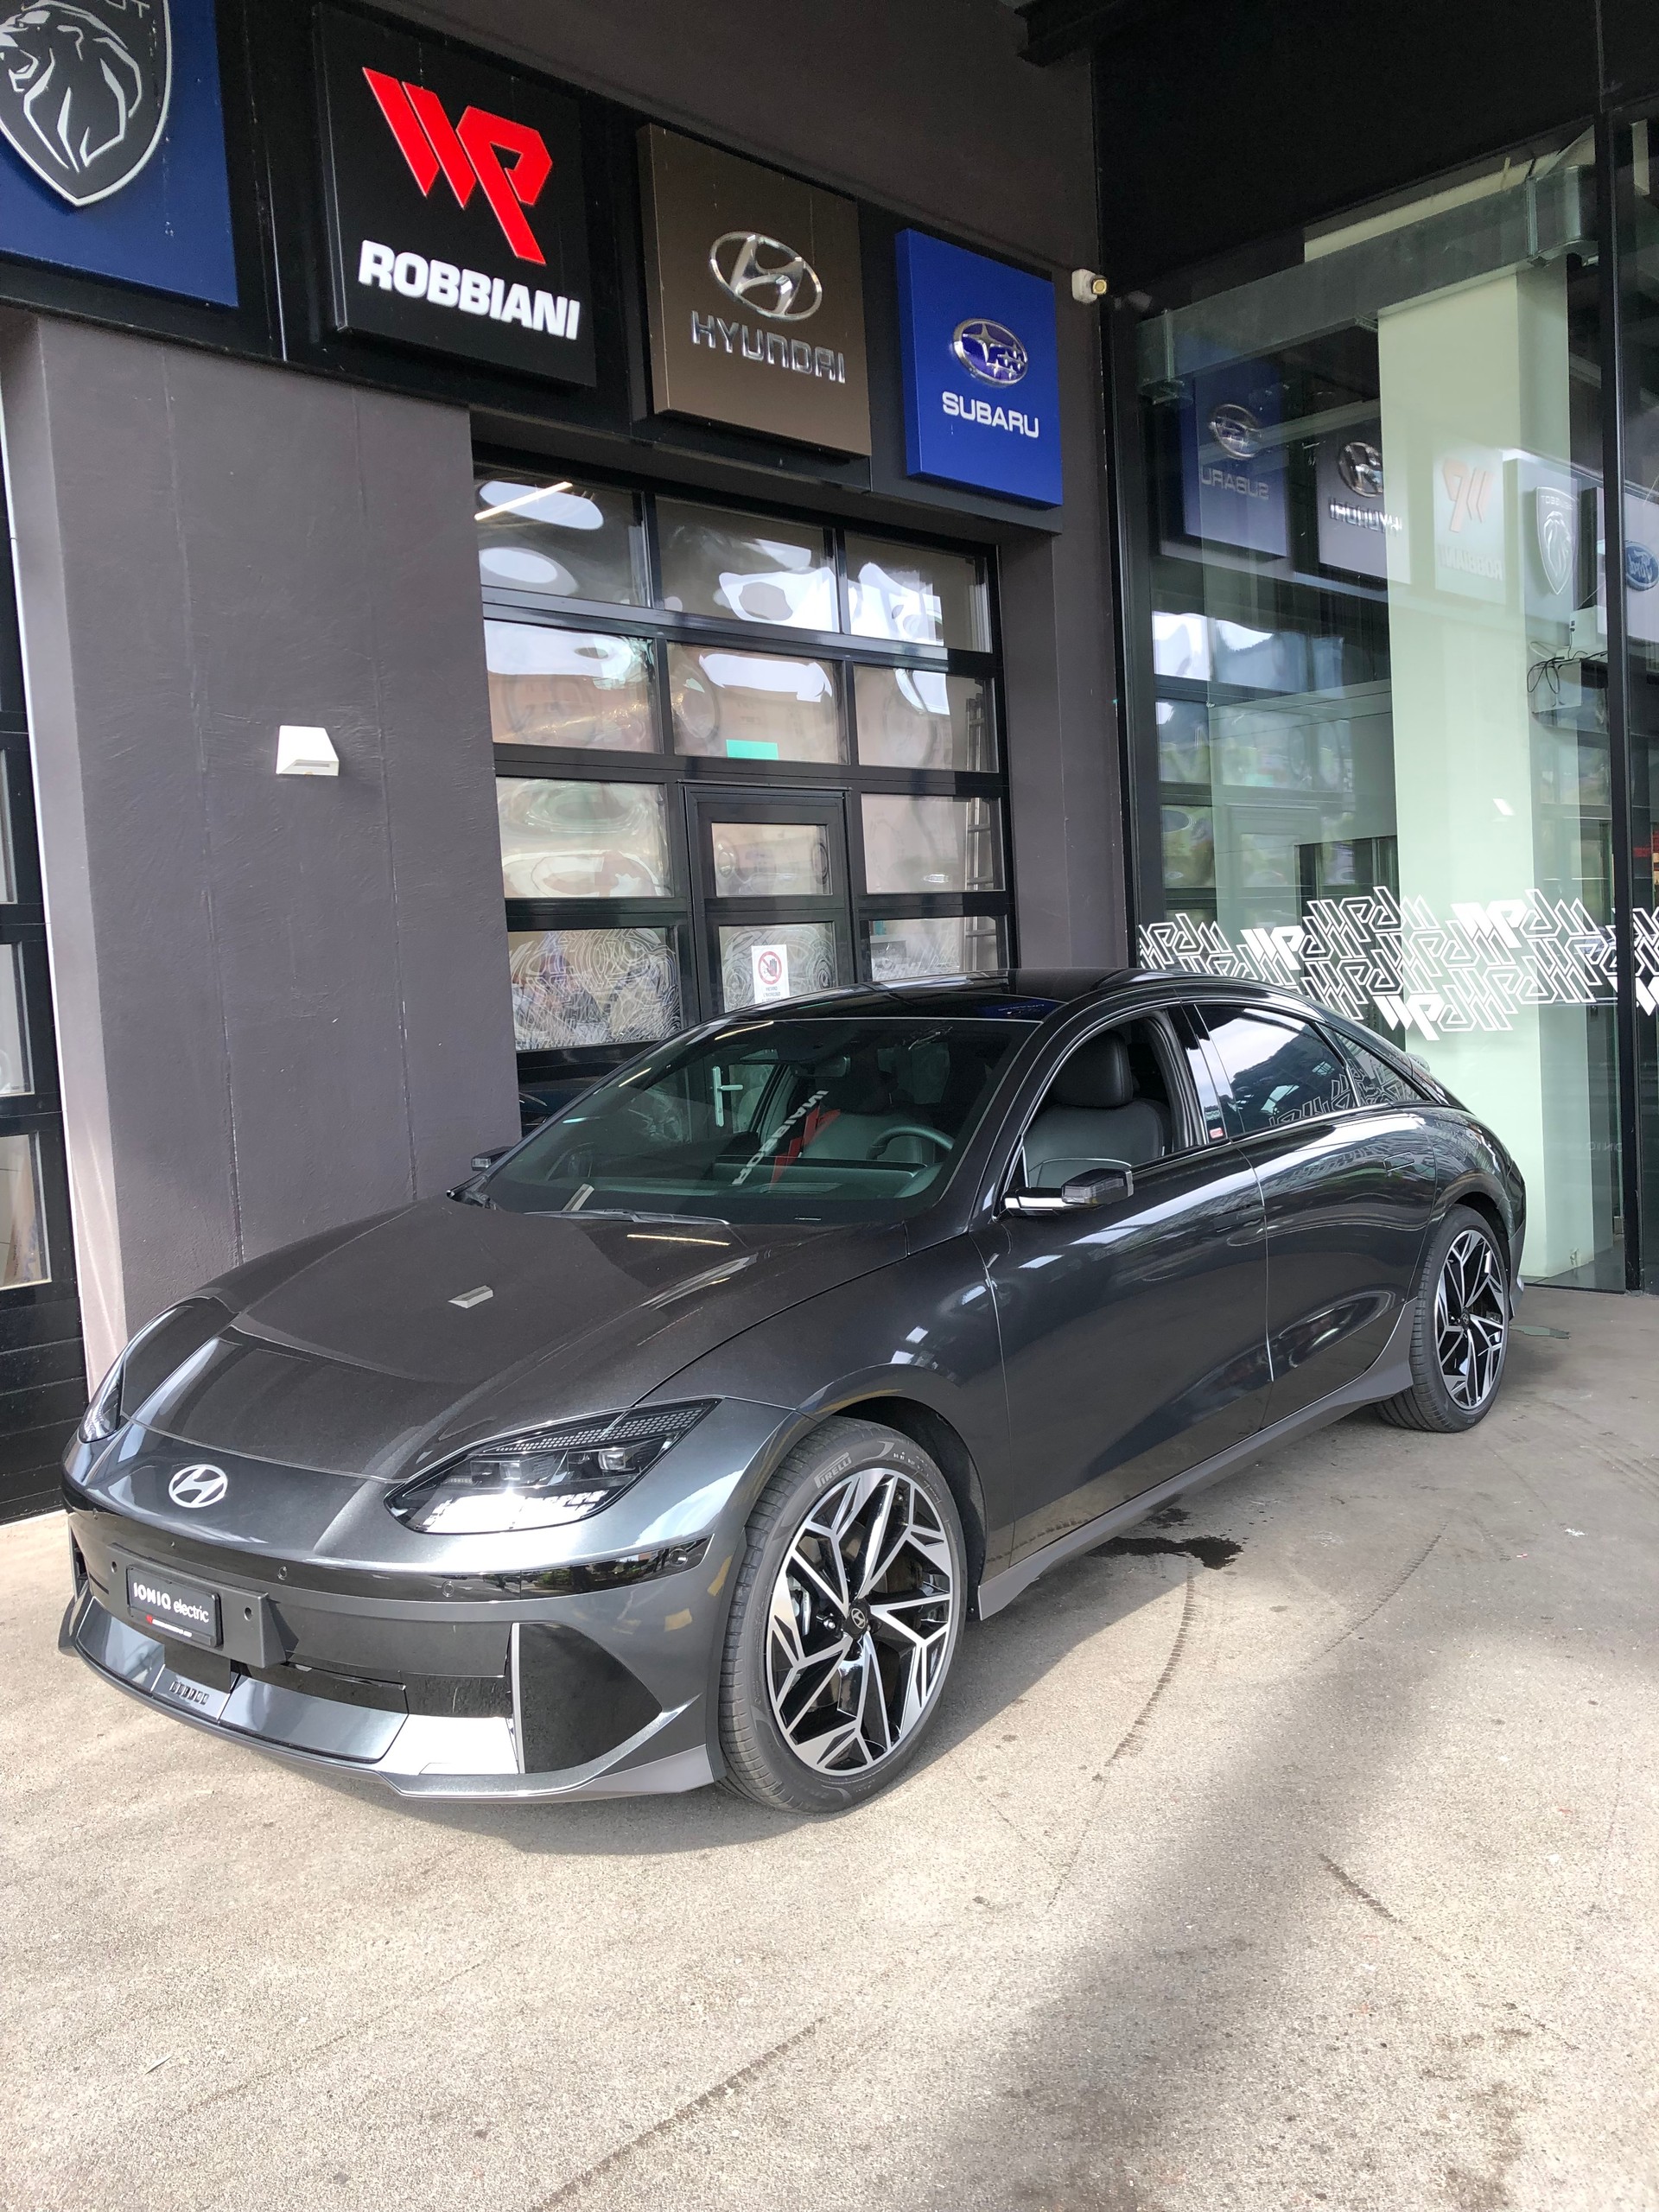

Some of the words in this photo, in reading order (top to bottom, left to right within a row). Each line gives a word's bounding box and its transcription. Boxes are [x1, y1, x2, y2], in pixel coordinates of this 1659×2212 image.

[357, 238, 582, 340] ROBBIANI
[691, 309, 847, 385] HYUNDAI
[942, 391, 1040, 439] SUBARU
[814, 1452, 853, 1489] PIRELLI
[133, 1581, 172, 1611] IONIQ
[173, 1598, 210, 1624] electric
